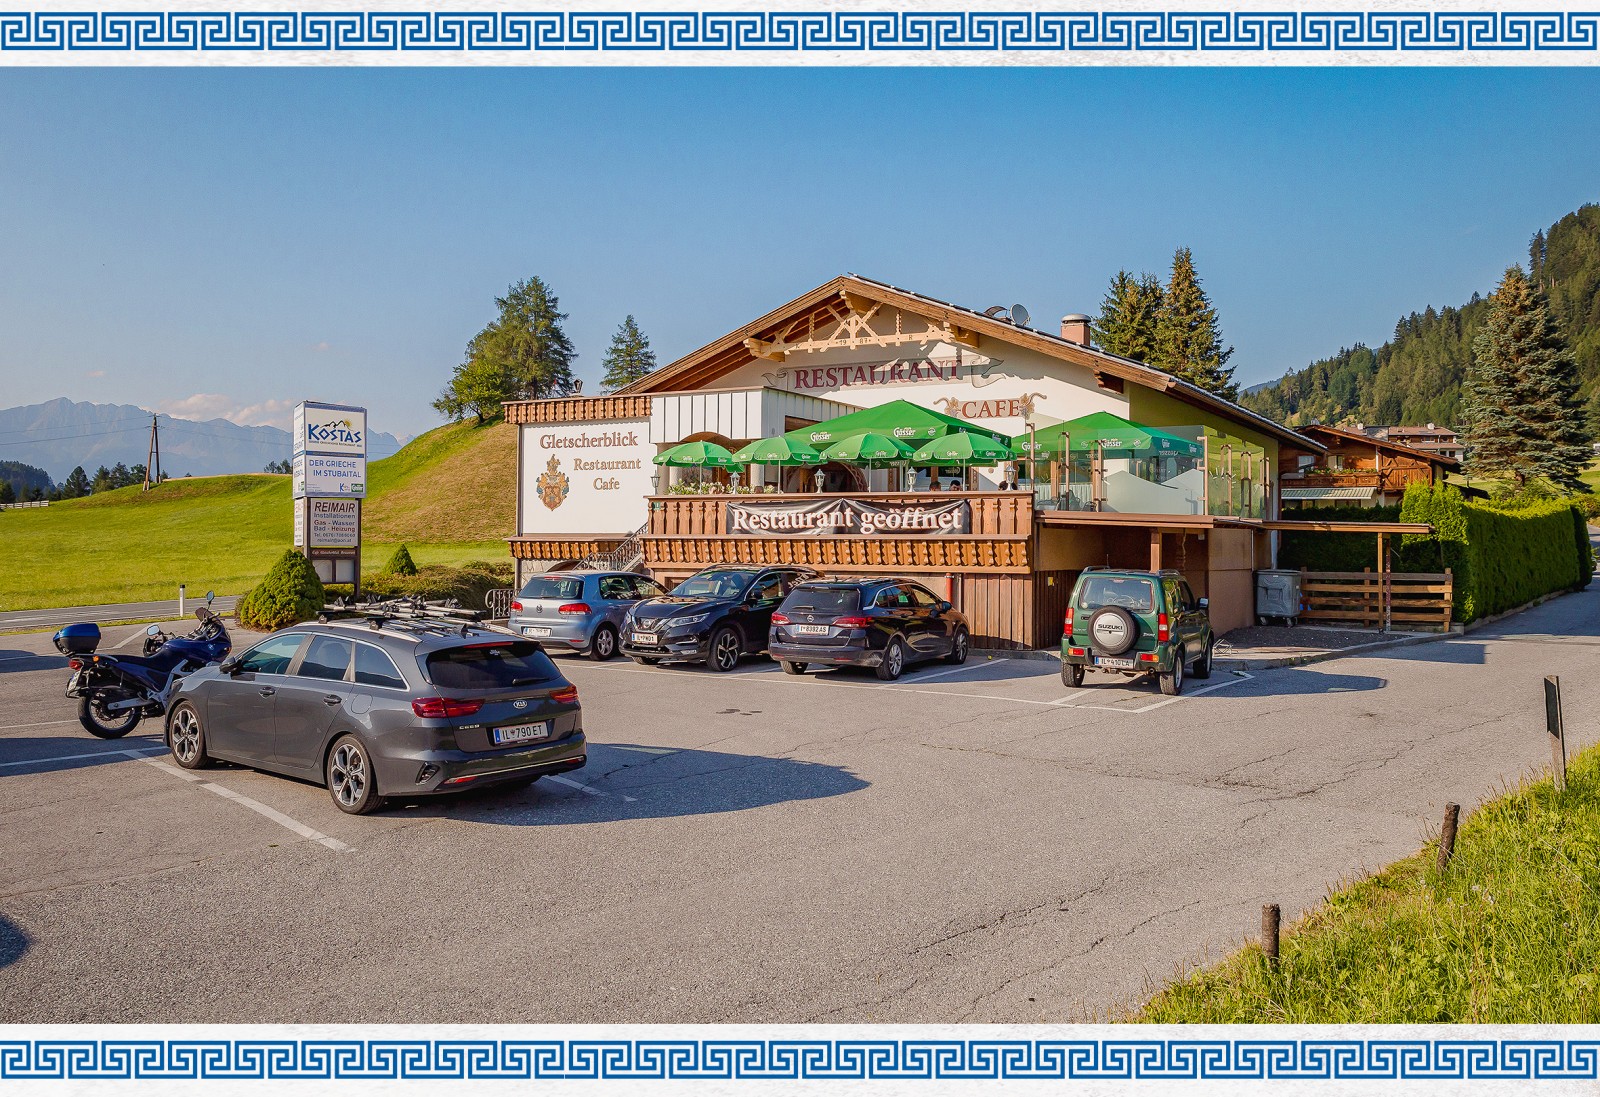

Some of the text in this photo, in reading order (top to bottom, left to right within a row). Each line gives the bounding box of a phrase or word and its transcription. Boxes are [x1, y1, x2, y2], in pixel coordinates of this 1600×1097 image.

[794, 359, 961, 389] RESTAURANT
[962, 399, 1020, 418] CAFE
[308, 424, 362, 443] KOSTAS
[540, 431, 638, 449] Gletscherblick
[326, 460, 356, 468] GRIECHE
[573, 458, 641, 471] Restaurant
[323, 470, 361, 478] STUBAITAL
[593, 477, 620, 490] Cafe
[315, 502, 355, 513] REIMAIR
[733, 506, 963, 534] Restaurant geöffnet
[502, 725, 542, 740] IL 790 ET
